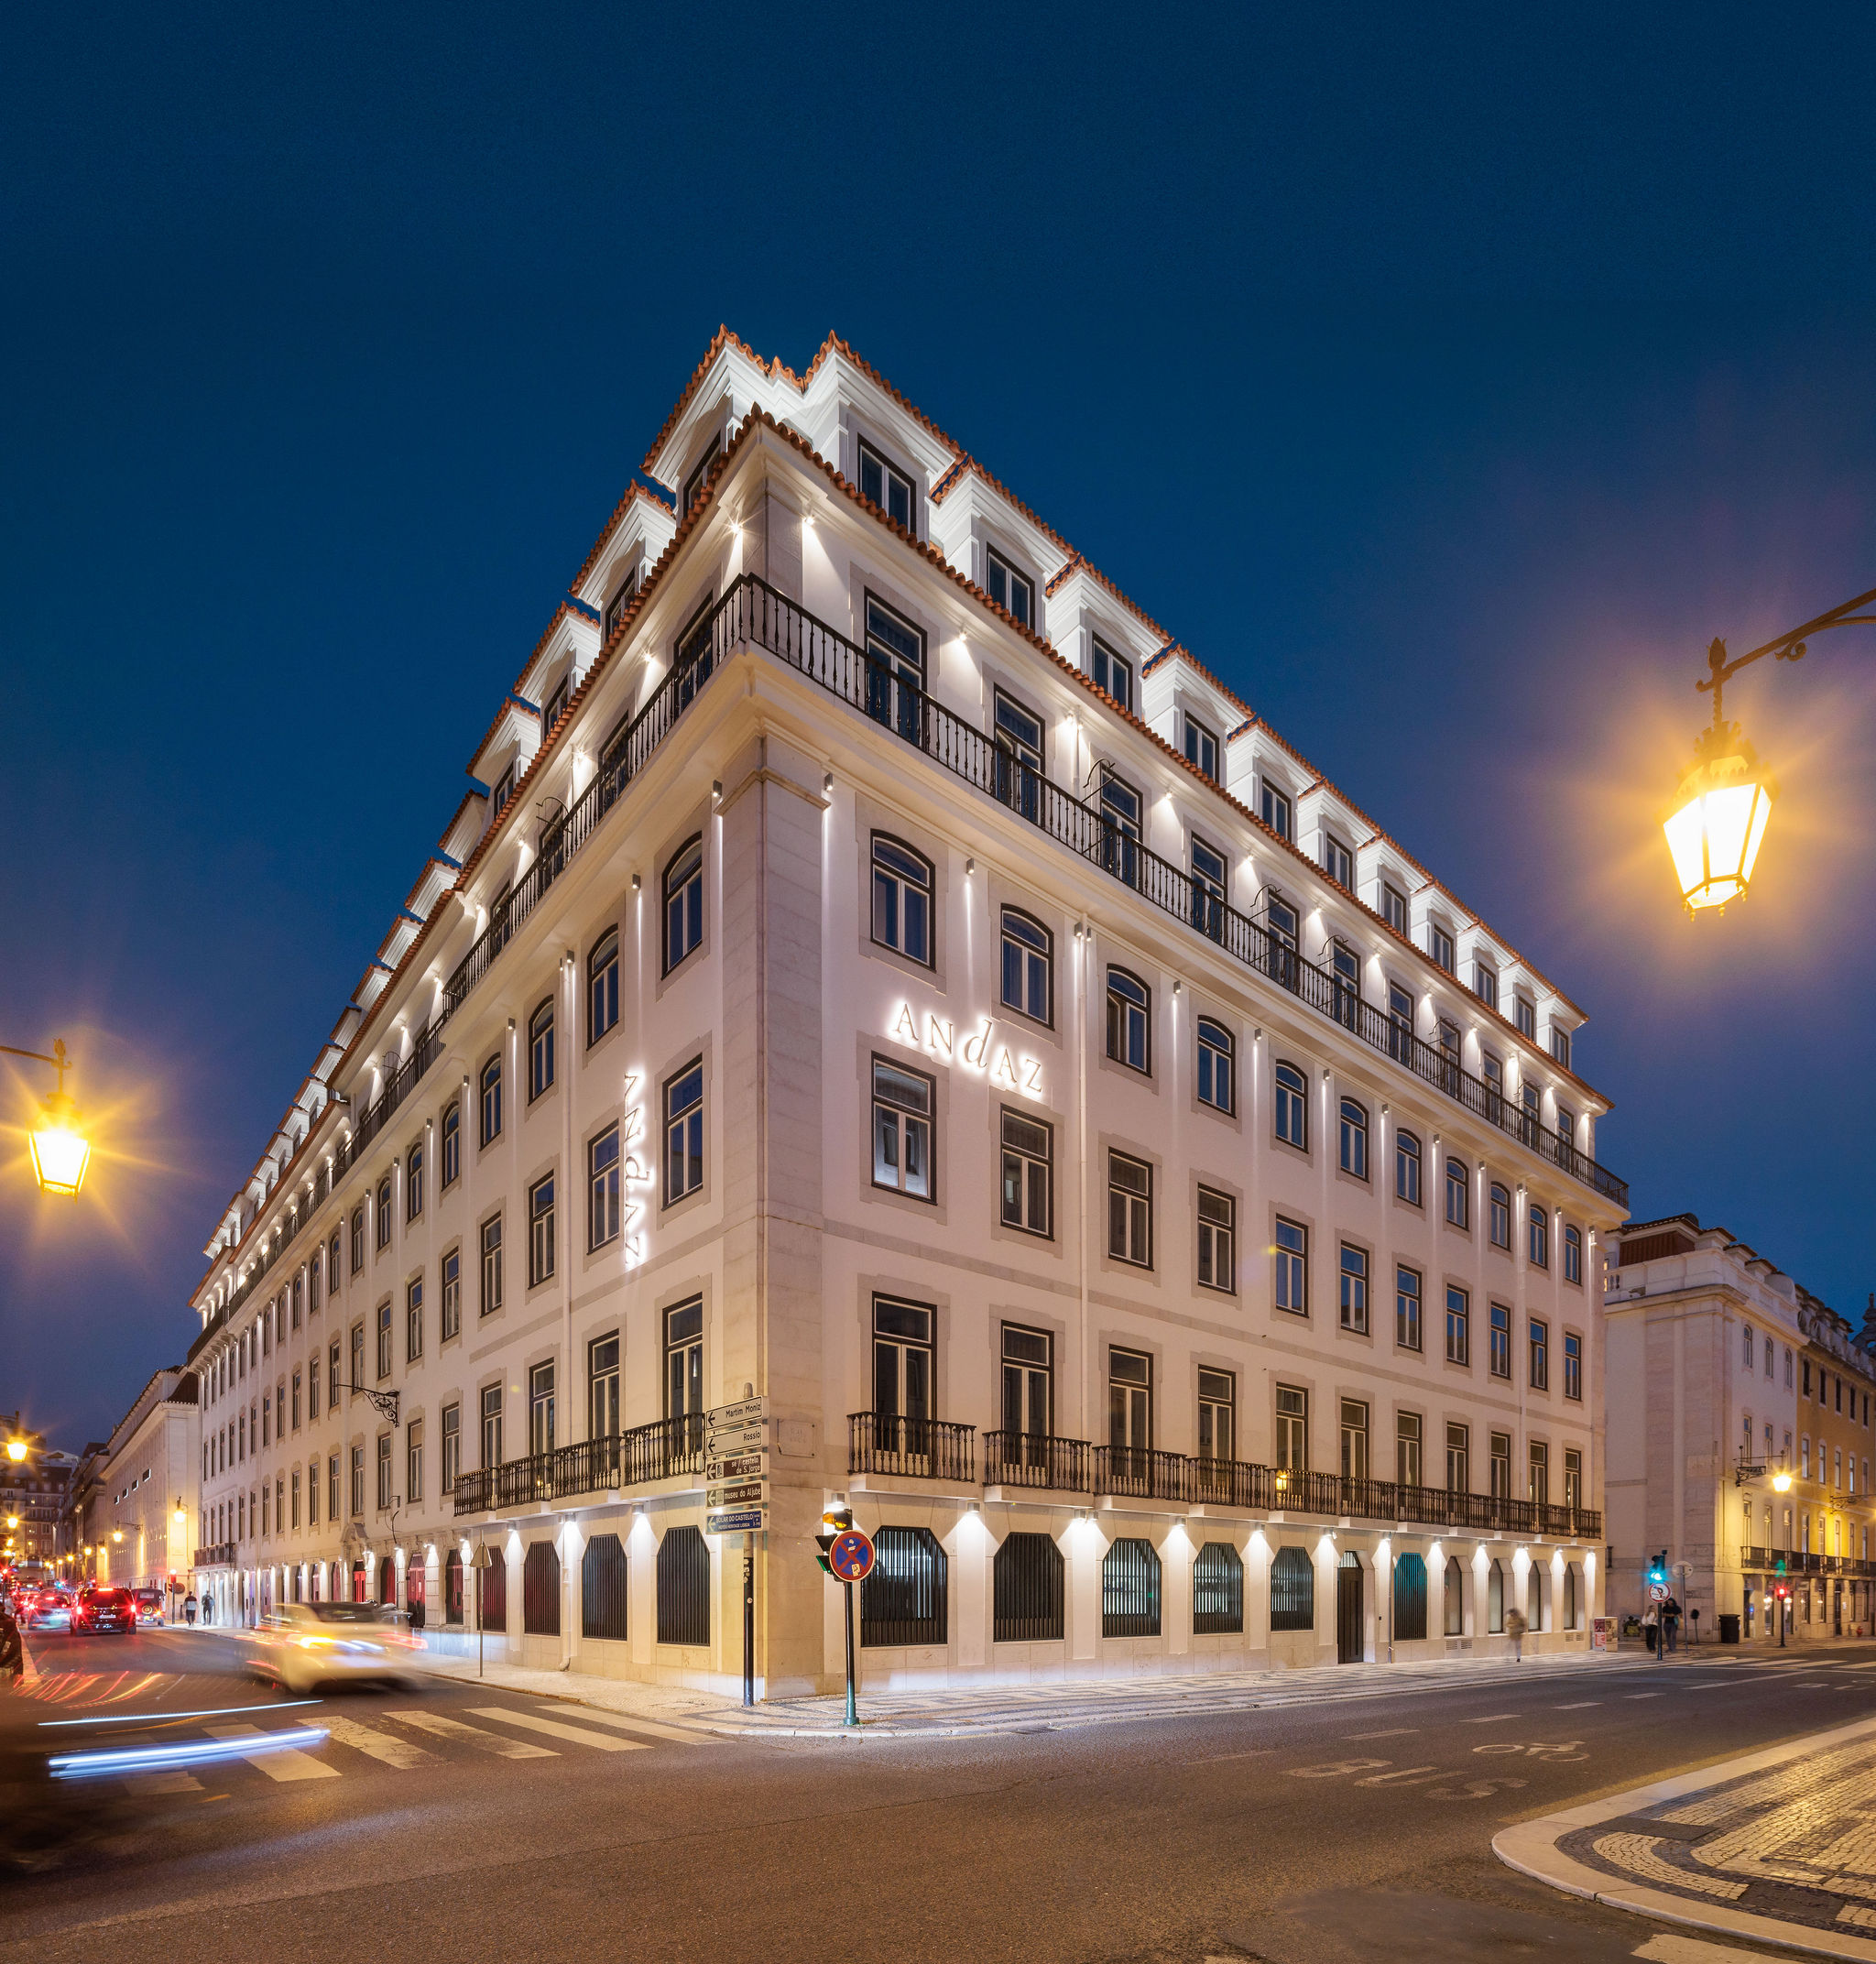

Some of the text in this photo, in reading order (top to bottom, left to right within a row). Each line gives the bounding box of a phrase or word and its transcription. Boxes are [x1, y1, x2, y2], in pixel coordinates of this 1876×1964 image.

[726, 1403, 761, 1418] Martim Moniz
[743, 1431, 761, 1441] Rossio
[742, 1457, 759, 1465] castelo
[739, 1489, 746, 1497] do
[747, 1488, 761, 1497] Aljube
[1279, 1757, 1531, 1801] BUS
